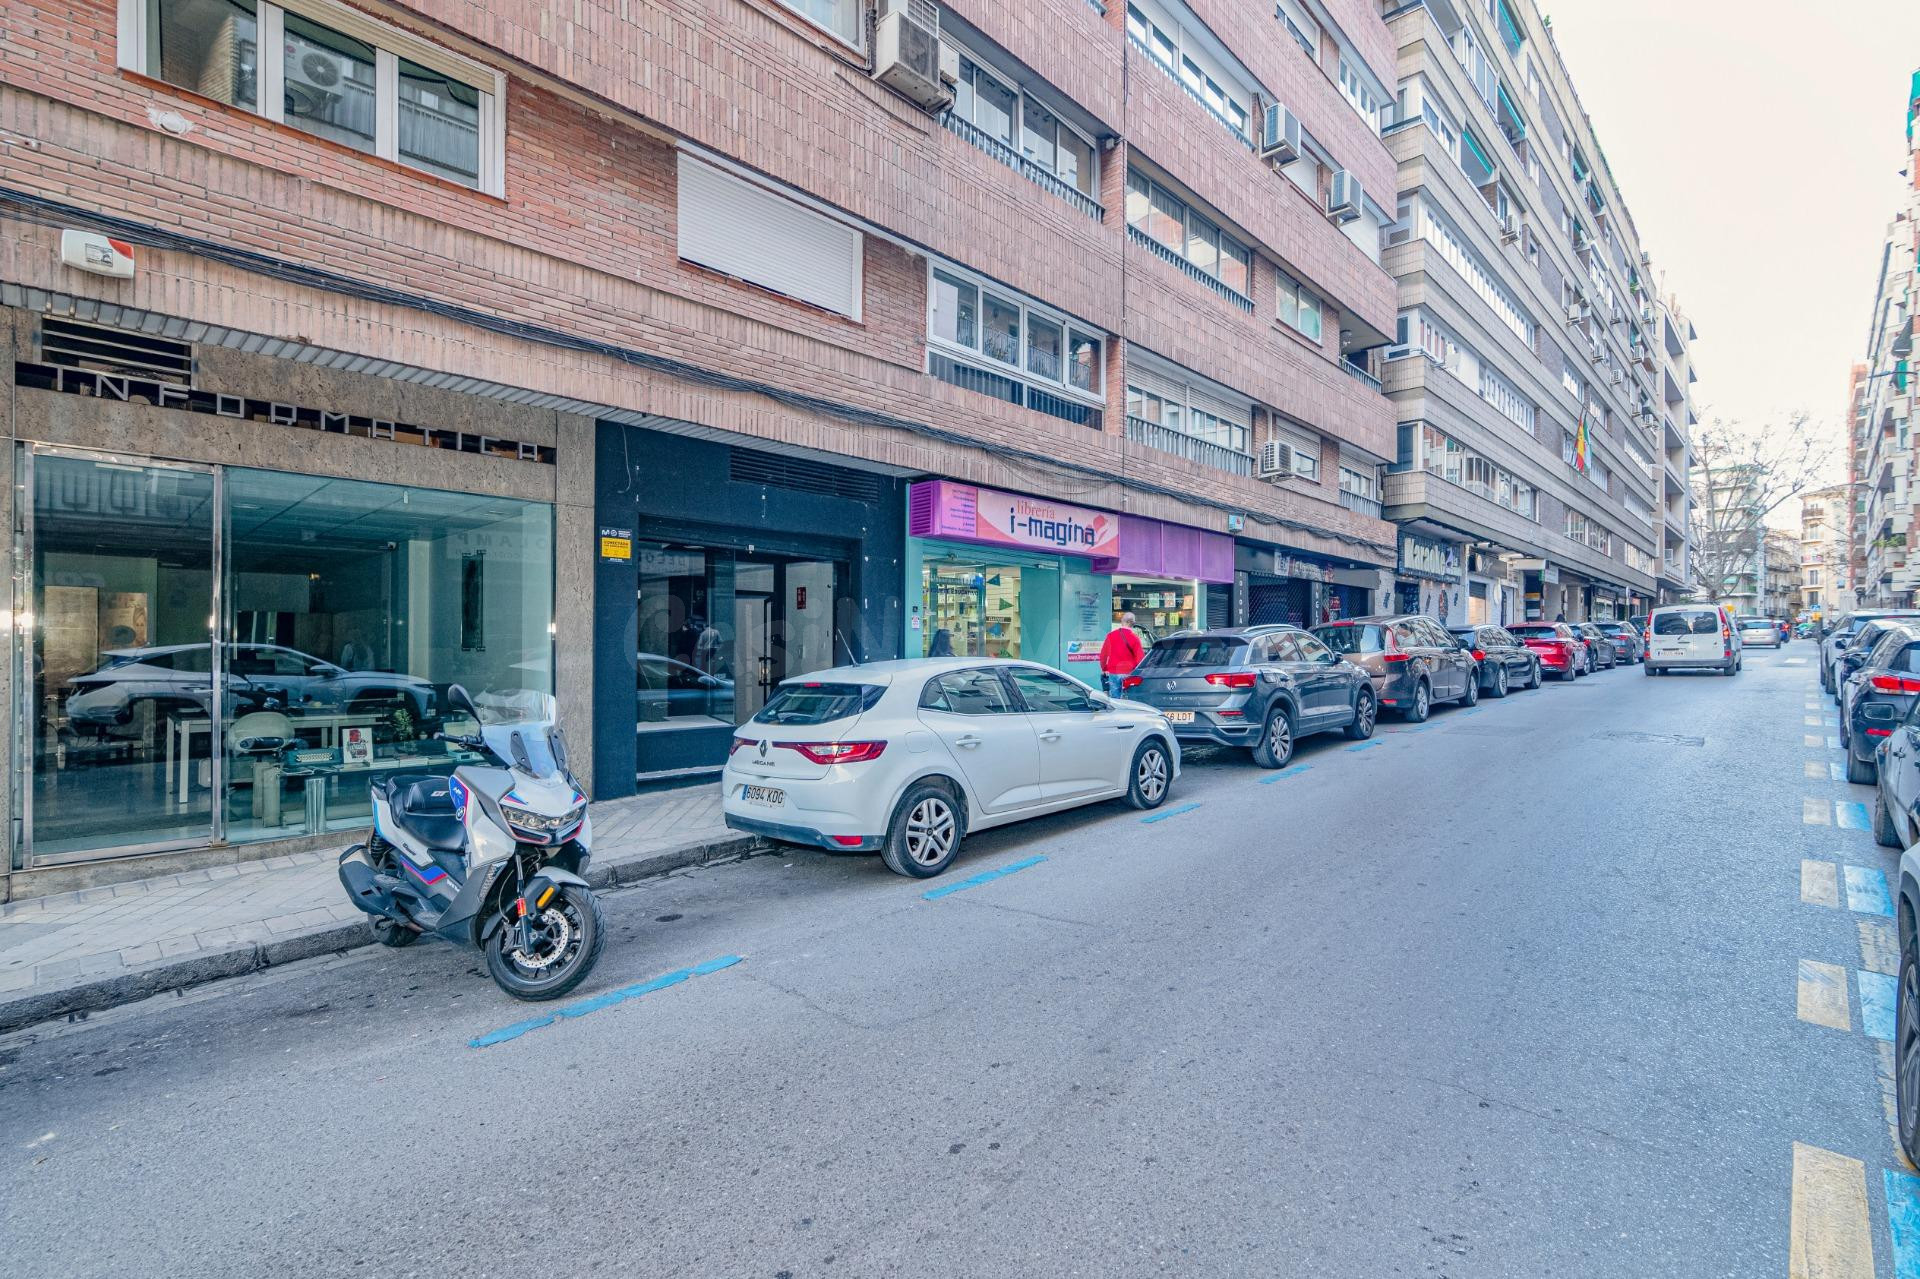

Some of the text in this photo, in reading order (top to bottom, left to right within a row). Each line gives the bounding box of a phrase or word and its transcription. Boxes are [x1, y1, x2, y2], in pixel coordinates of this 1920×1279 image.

[55, 367, 539, 462] INFORMATICA
[1016, 500, 1056, 519] librería
[747, 787, 765, 801] 6094
